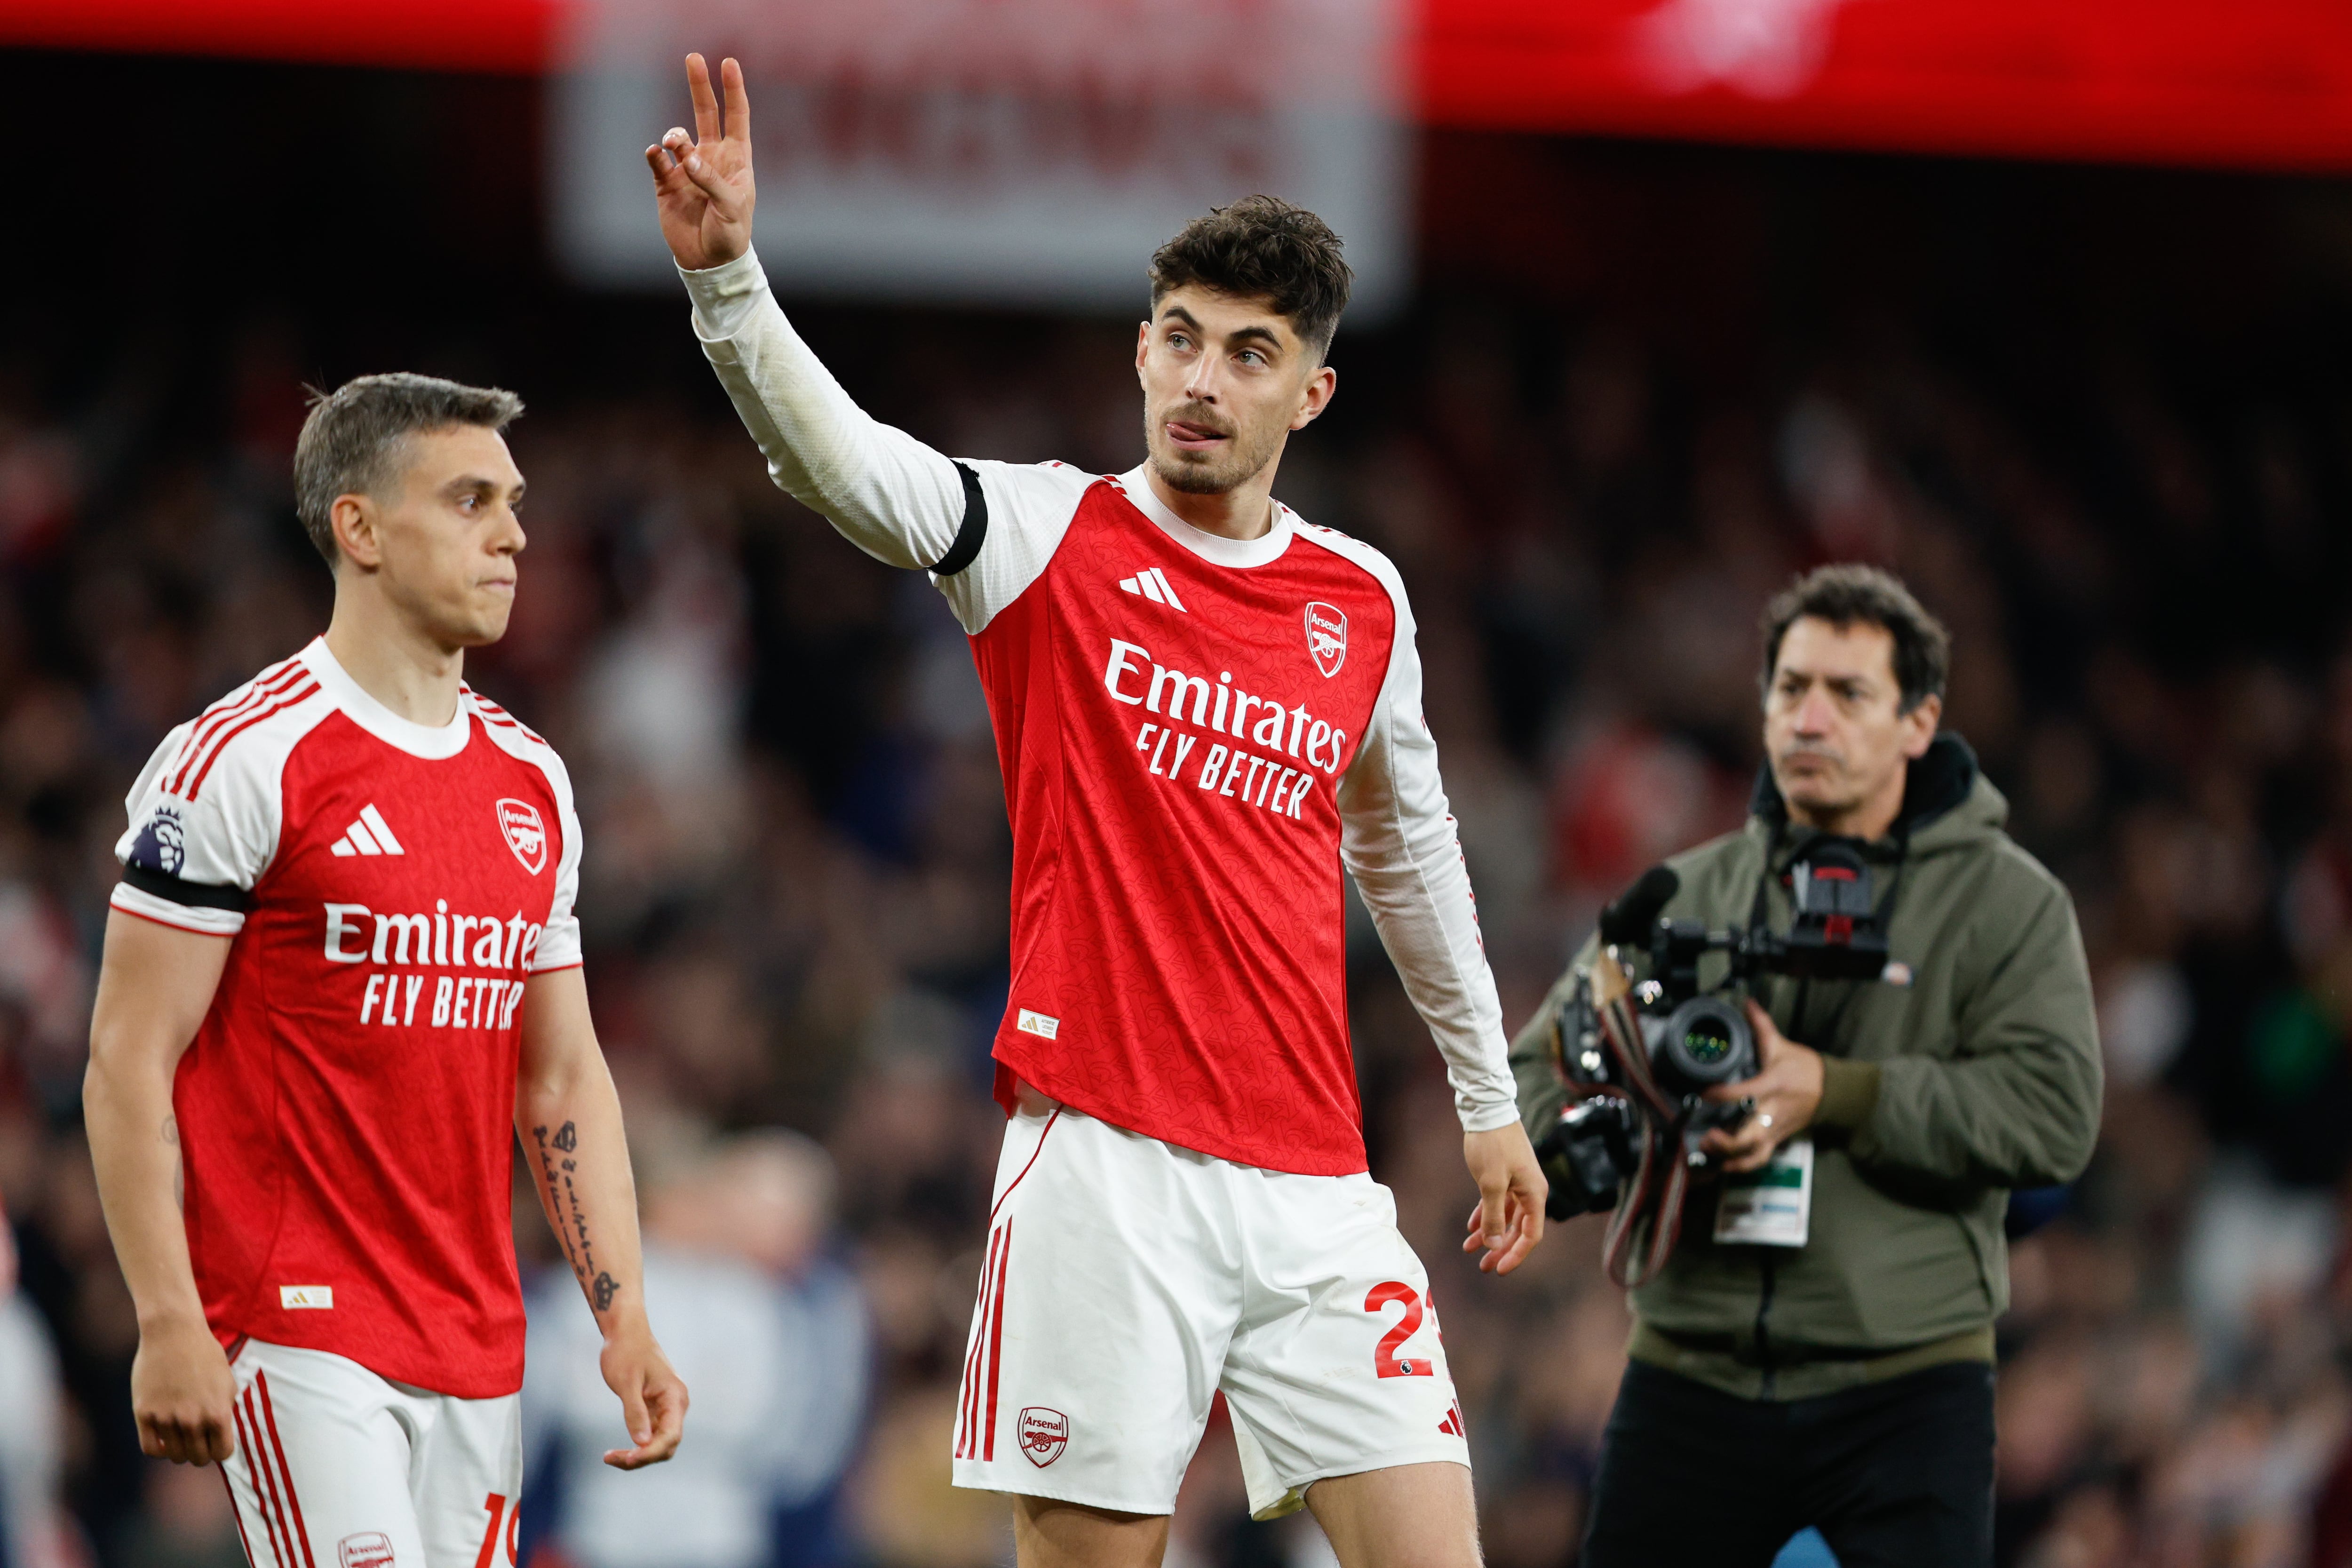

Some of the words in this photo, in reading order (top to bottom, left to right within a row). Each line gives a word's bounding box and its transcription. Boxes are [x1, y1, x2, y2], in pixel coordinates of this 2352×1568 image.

[1311, 613, 1341, 636] Arsenal
[1104, 637, 1346, 774] Emirates
[1136, 722, 1197, 780] FLY
[1198, 742, 1314, 820] BETTER
[324, 899, 541, 972] Emirate
[360, 974, 424, 1027] FLY
[1025, 1416, 1061, 1431] Arsenal
[346, 1542, 384, 1555] Arsenal
